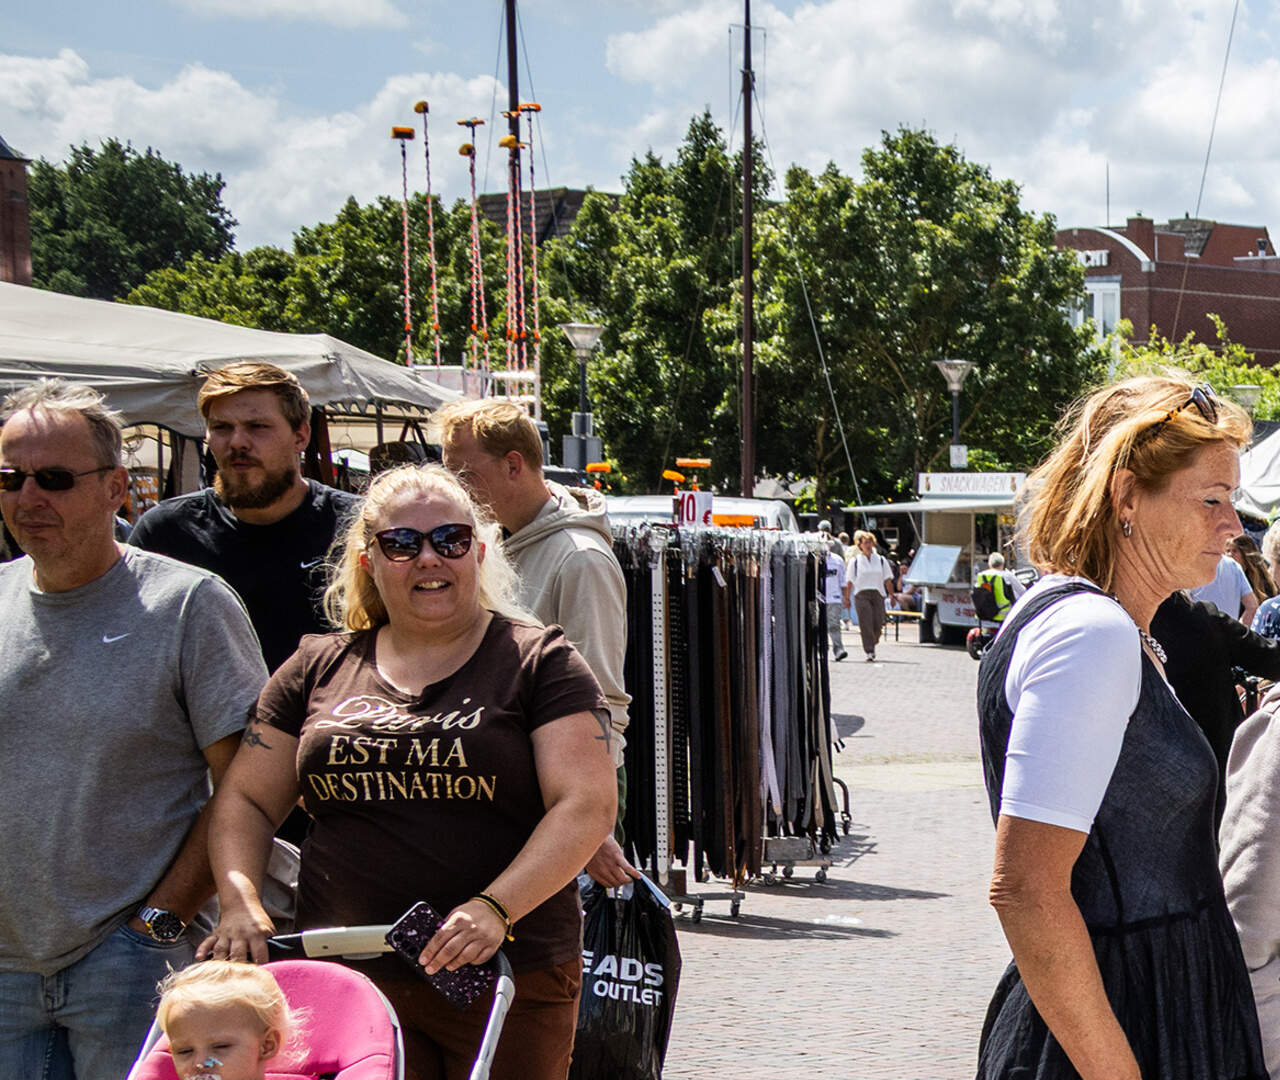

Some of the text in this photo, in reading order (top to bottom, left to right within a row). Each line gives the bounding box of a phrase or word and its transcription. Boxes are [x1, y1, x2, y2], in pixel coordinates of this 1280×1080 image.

[939, 476, 1007, 492] SNACKWAGEN
[314, 695, 486, 731] Paris
[326, 735, 469, 769] EST MA
[307, 770, 497, 802] DESTINATION
[593, 979, 664, 1007] OUTLET
